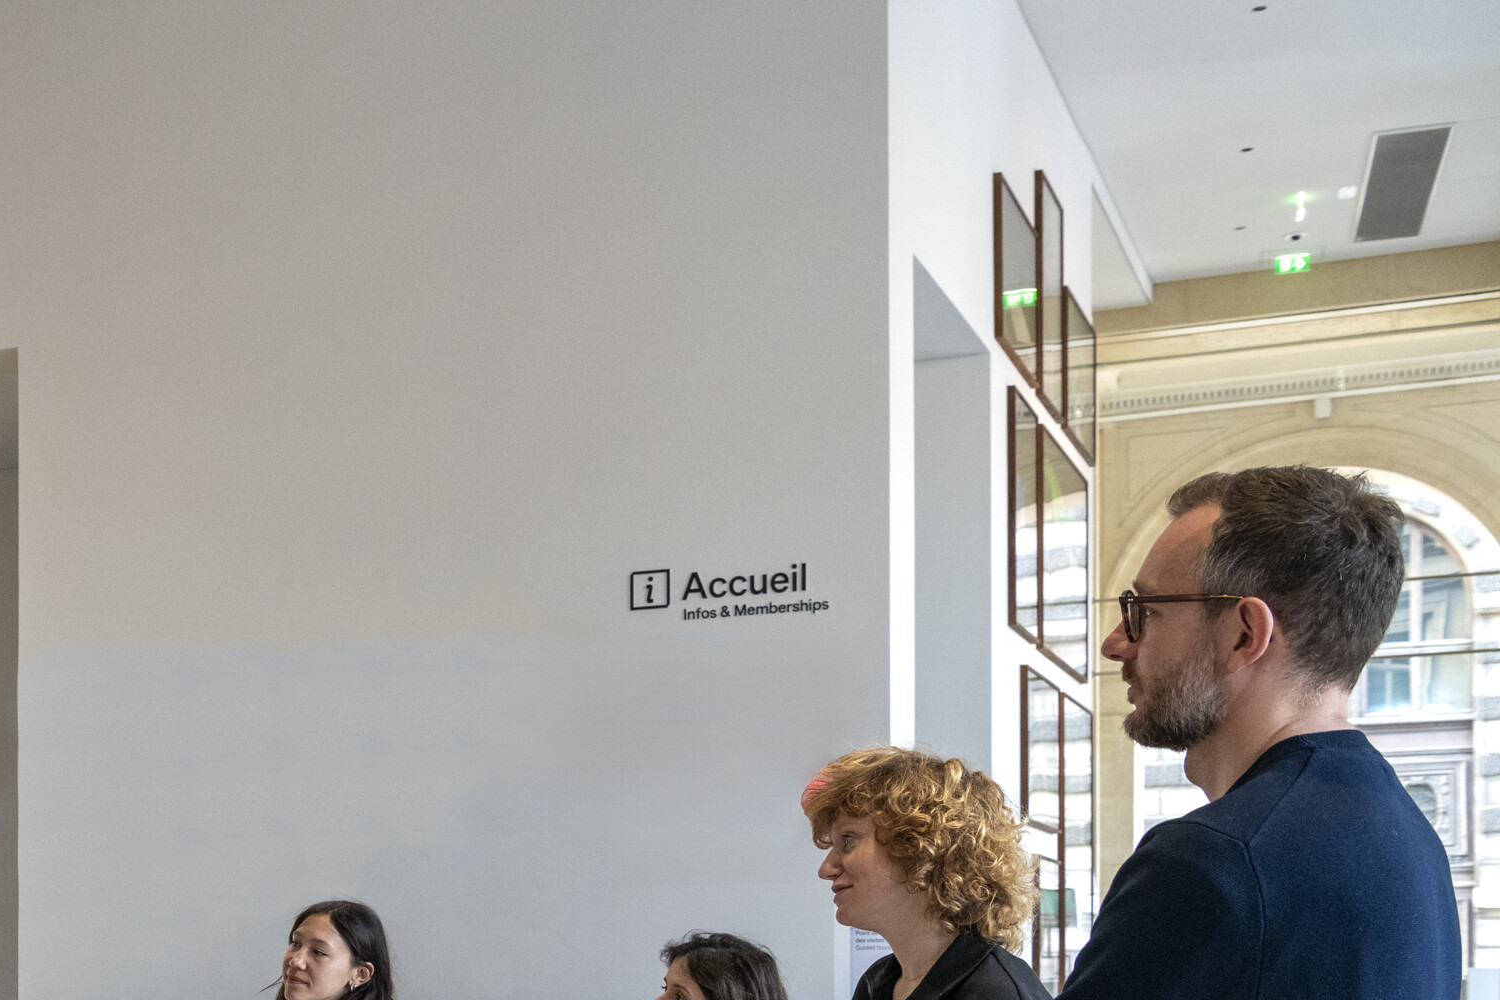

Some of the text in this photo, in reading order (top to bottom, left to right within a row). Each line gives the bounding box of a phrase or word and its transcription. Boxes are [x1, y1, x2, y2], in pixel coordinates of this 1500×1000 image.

[682, 562, 806, 600] Accueil
[683, 599, 829, 620] Infos & Memberships
